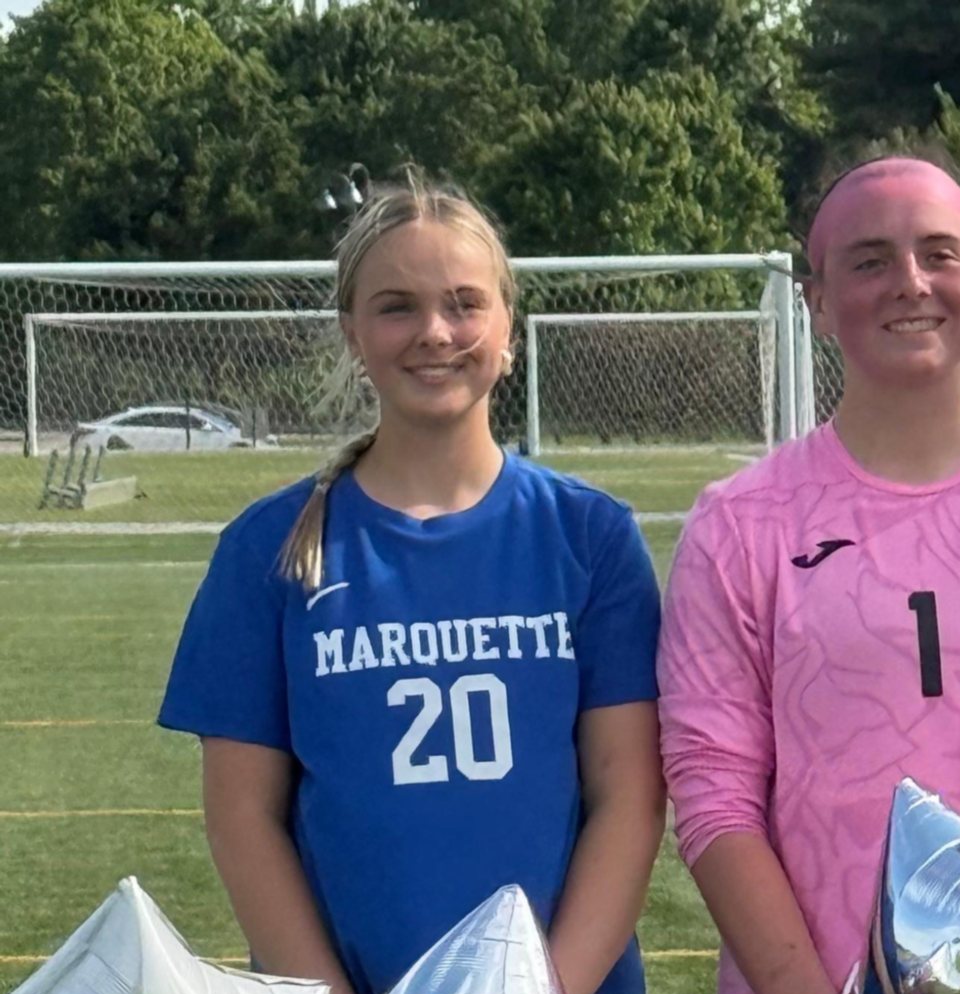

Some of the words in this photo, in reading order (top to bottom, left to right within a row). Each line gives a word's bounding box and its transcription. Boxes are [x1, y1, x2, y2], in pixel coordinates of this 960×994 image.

[313, 611, 576, 677] MARQUETTE
[907, 591, 943, 698] 1
[387, 673, 514, 785] 20
